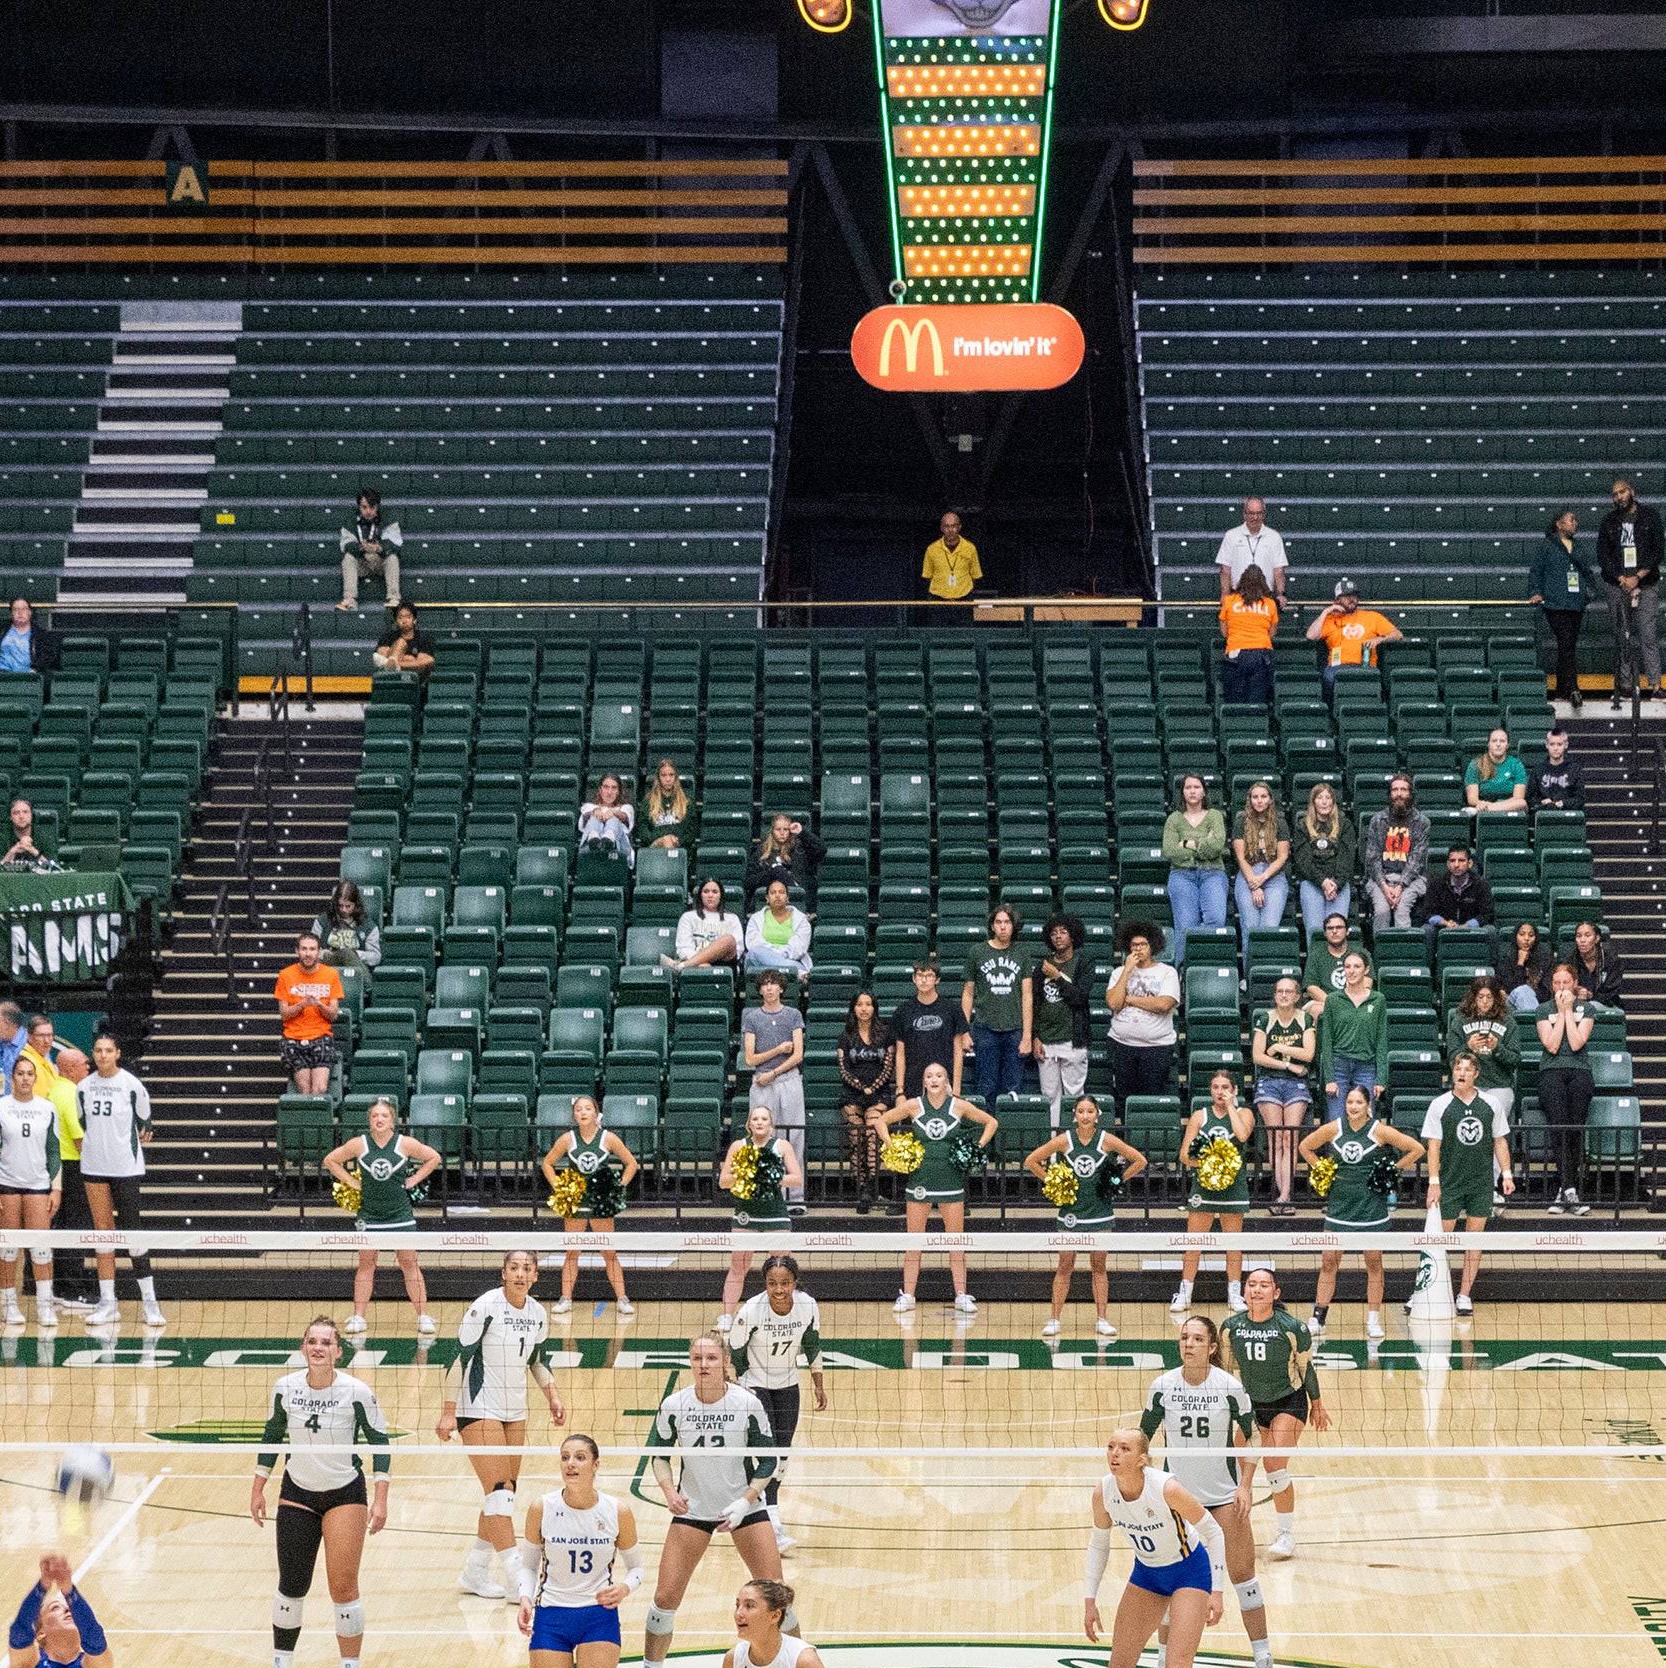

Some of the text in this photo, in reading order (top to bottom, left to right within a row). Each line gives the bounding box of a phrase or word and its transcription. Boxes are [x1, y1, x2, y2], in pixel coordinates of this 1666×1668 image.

[169, 166, 206, 202] A
[954, 337, 982, 356] I'm
[984, 337, 1035, 356] lovin'
[52, 893, 107, 912] STATE
[981, 956, 1021, 974] CSU RAMS
[91, 1100, 113, 1118] 33
[22, 1122, 31, 1138] 8
[80, 1231, 127, 1243] uchealth
[200, 1232, 247, 1244] uchealth
[321, 1233, 368, 1245] uchealth
[442, 1233, 489, 1245] uchealth
[563, 1233, 610, 1246] uchealth
[684, 1234, 731, 1246] uchealth
[805, 1234, 852, 1246] uchealth
[926, 1234, 974, 1246] uchealth
[1048, 1234, 1095, 1246] uchealth
[1169, 1234, 1217, 1246] uchealth
[1291, 1234, 1339, 1246] uchealth
[1413, 1234, 1460, 1246] uchealth
[1535, 1234, 1582, 1246] uchealth
[512, 1324, 532, 1332] STATE
[763, 1321, 802, 1331] COLORADO
[771, 1329, 795, 1337] STATE
[1235, 1328, 1279, 1338] COLORADO
[519, 1337, 526, 1357] 1
[770, 1340, 793, 1356] 17
[1244, 1342, 1266, 1361] 18
[291, 1398, 339, 1408] COLORADO
[1171, 1394, 1219, 1404] COLORADO
[1181, 1403, 1209, 1411] STATE
[304, 1414, 321, 1433] 4
[686, 1413, 735, 1423] COLORADO
[695, 1421, 724, 1430] STATE
[1180, 1416, 1210, 1438] 26
[1143, 1521, 1165, 1531] STATE
[551, 1535, 610, 1545] SAN JOSÉ STATE
[1130, 1533, 1156, 1553] 10
[568, 1550, 594, 1574] 13
